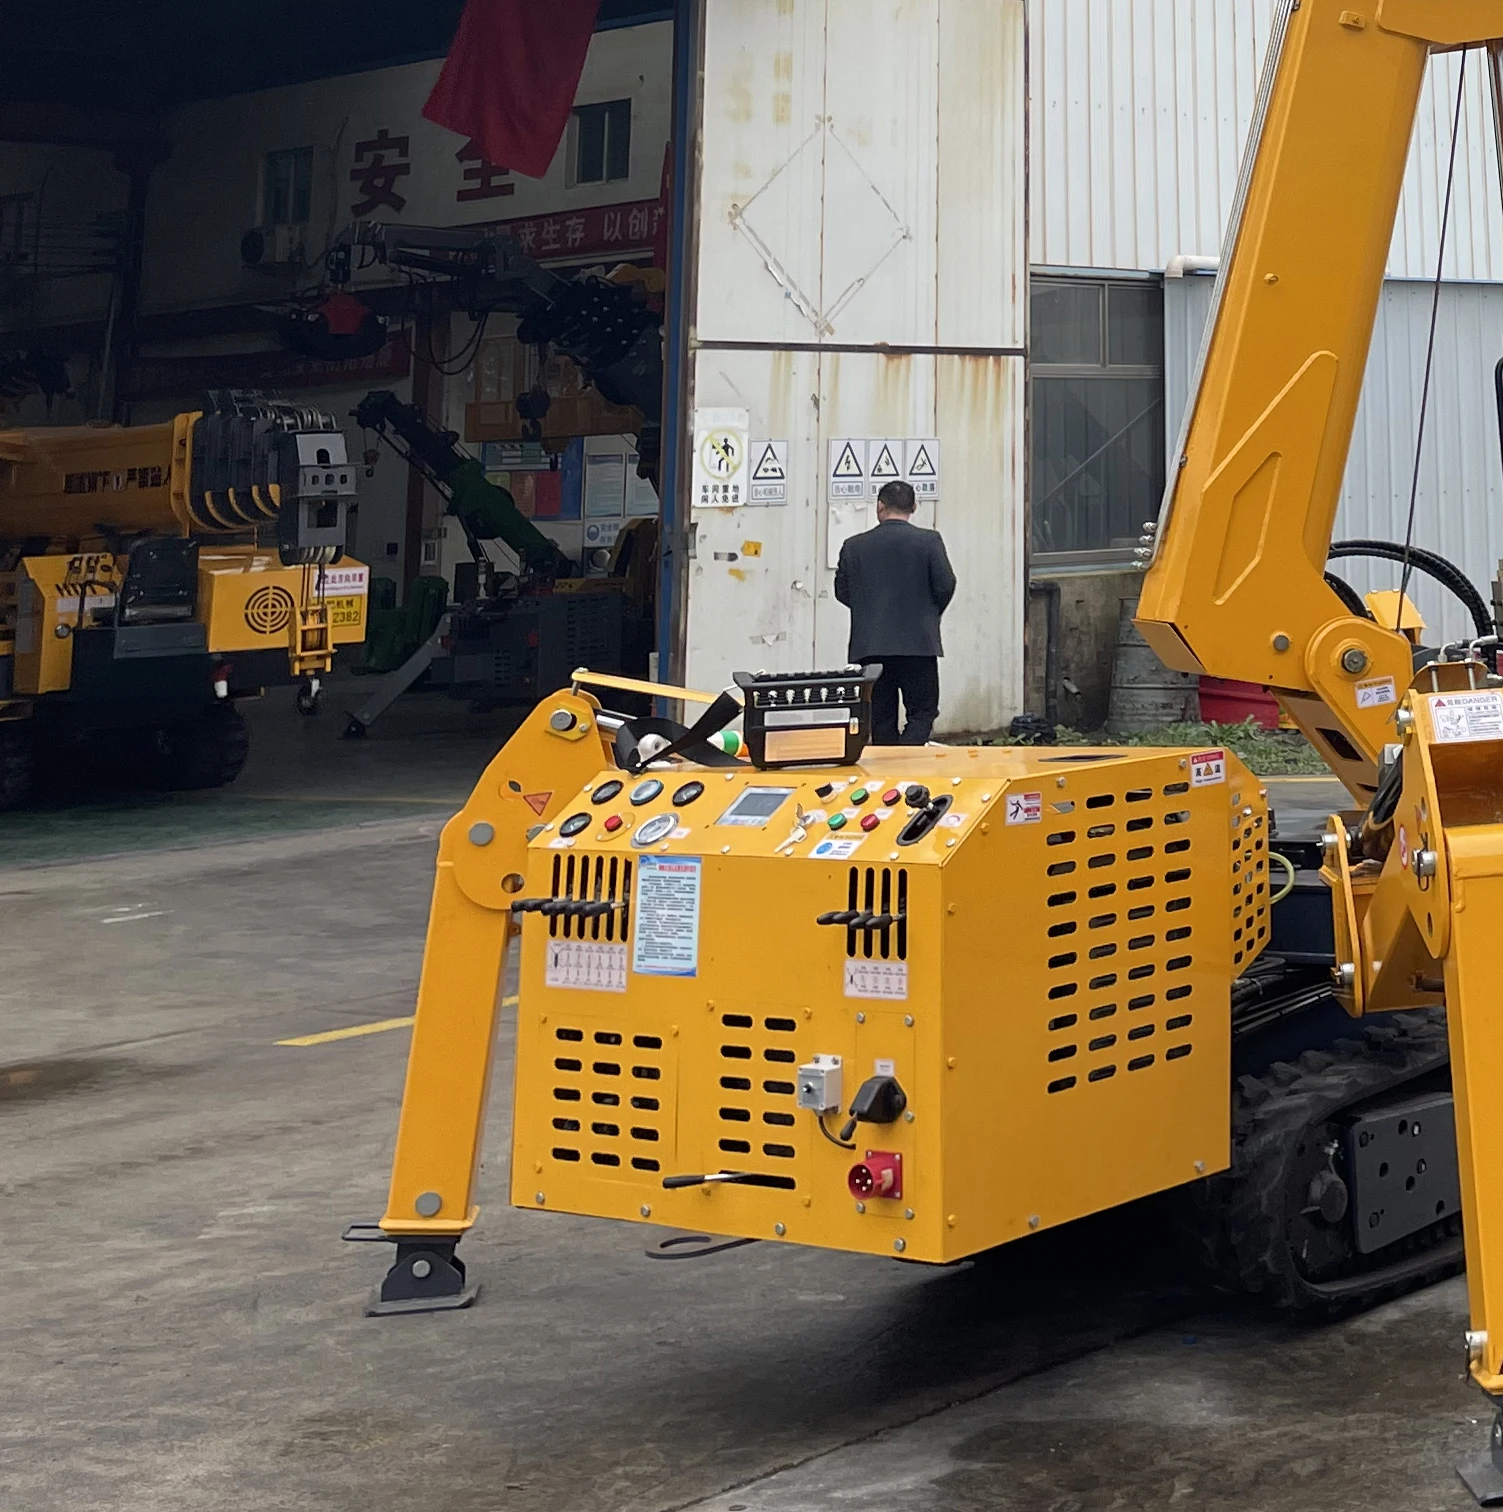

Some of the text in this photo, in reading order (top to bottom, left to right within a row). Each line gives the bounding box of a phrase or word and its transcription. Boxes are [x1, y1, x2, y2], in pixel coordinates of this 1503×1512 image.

[498, 215, 586, 250] 求生存
[701, 484, 739, 494] 车间重地
[701, 494, 739, 504] 闲人免进
